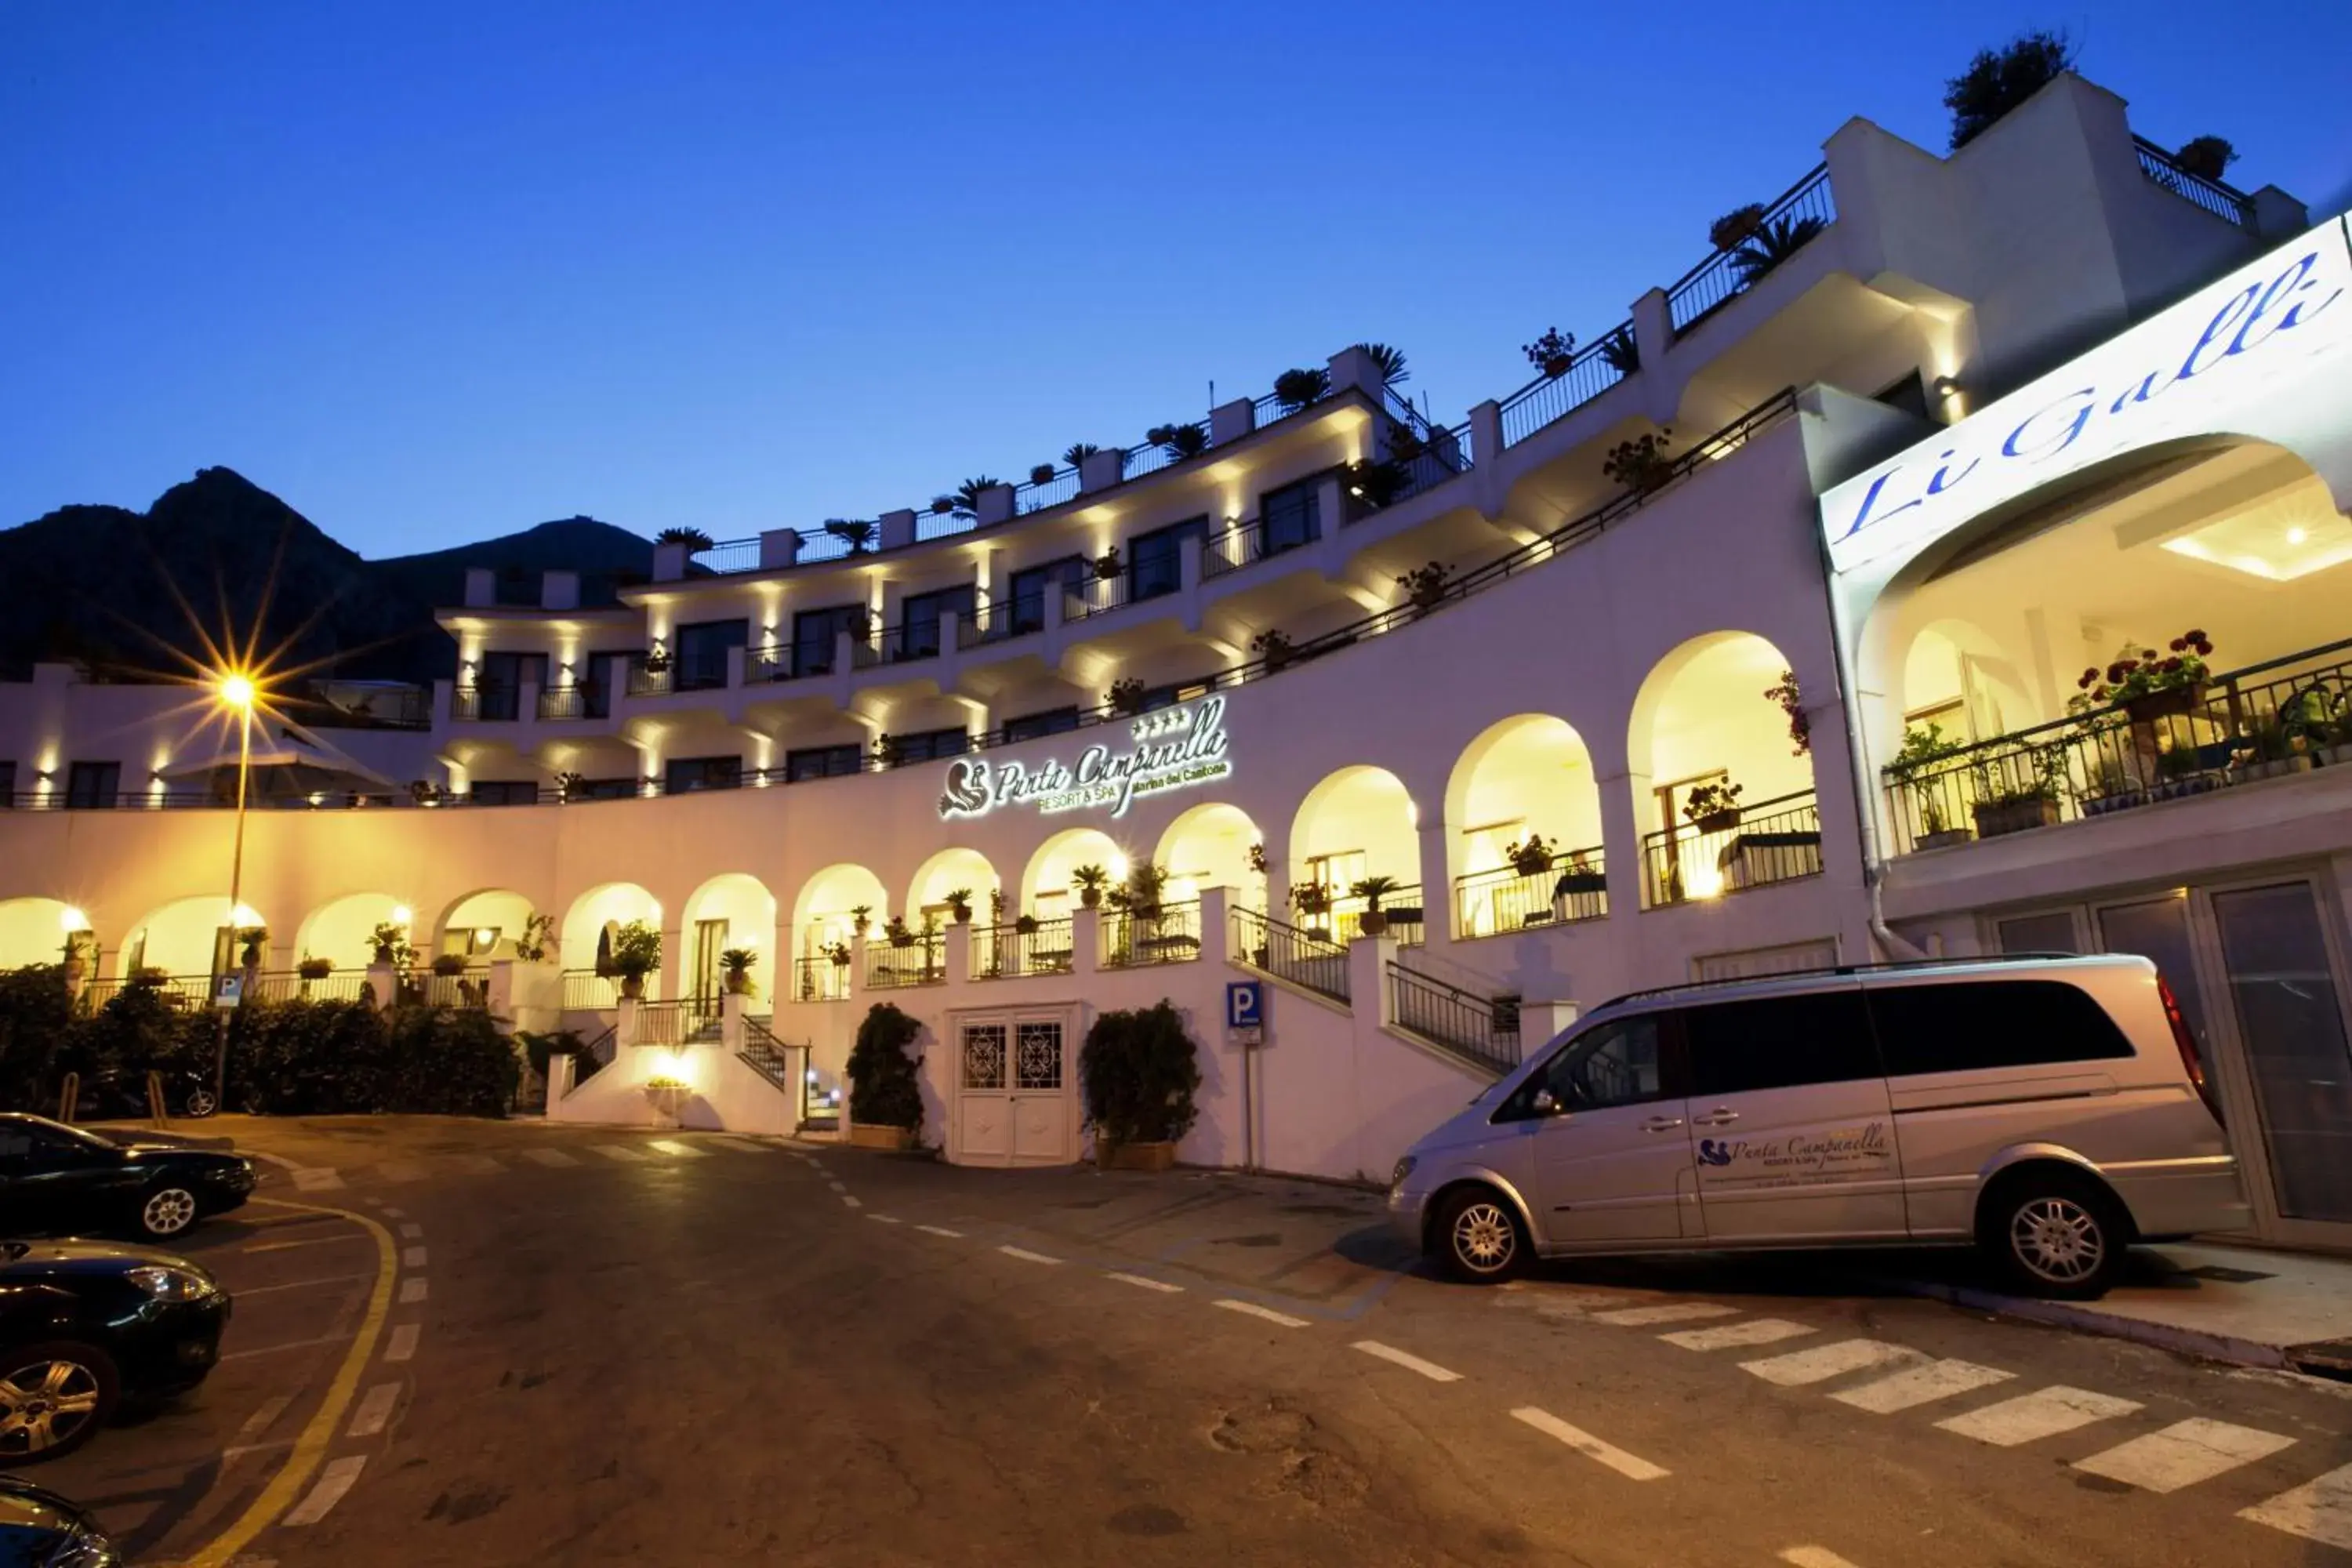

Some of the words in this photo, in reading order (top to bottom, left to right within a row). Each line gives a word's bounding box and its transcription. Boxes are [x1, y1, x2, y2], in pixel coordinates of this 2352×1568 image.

[1831, 448, 1980, 546] Li
[2002, 251, 2344, 465] Galli
[994, 760, 1069, 800] Punta
[1076, 697, 1228, 815] Campanella
[1037, 791, 1082, 810] RESORT
[1084, 789, 1091, 802] &
[1095, 786, 1115, 800] SPA
[1233, 987, 1254, 1024] P
